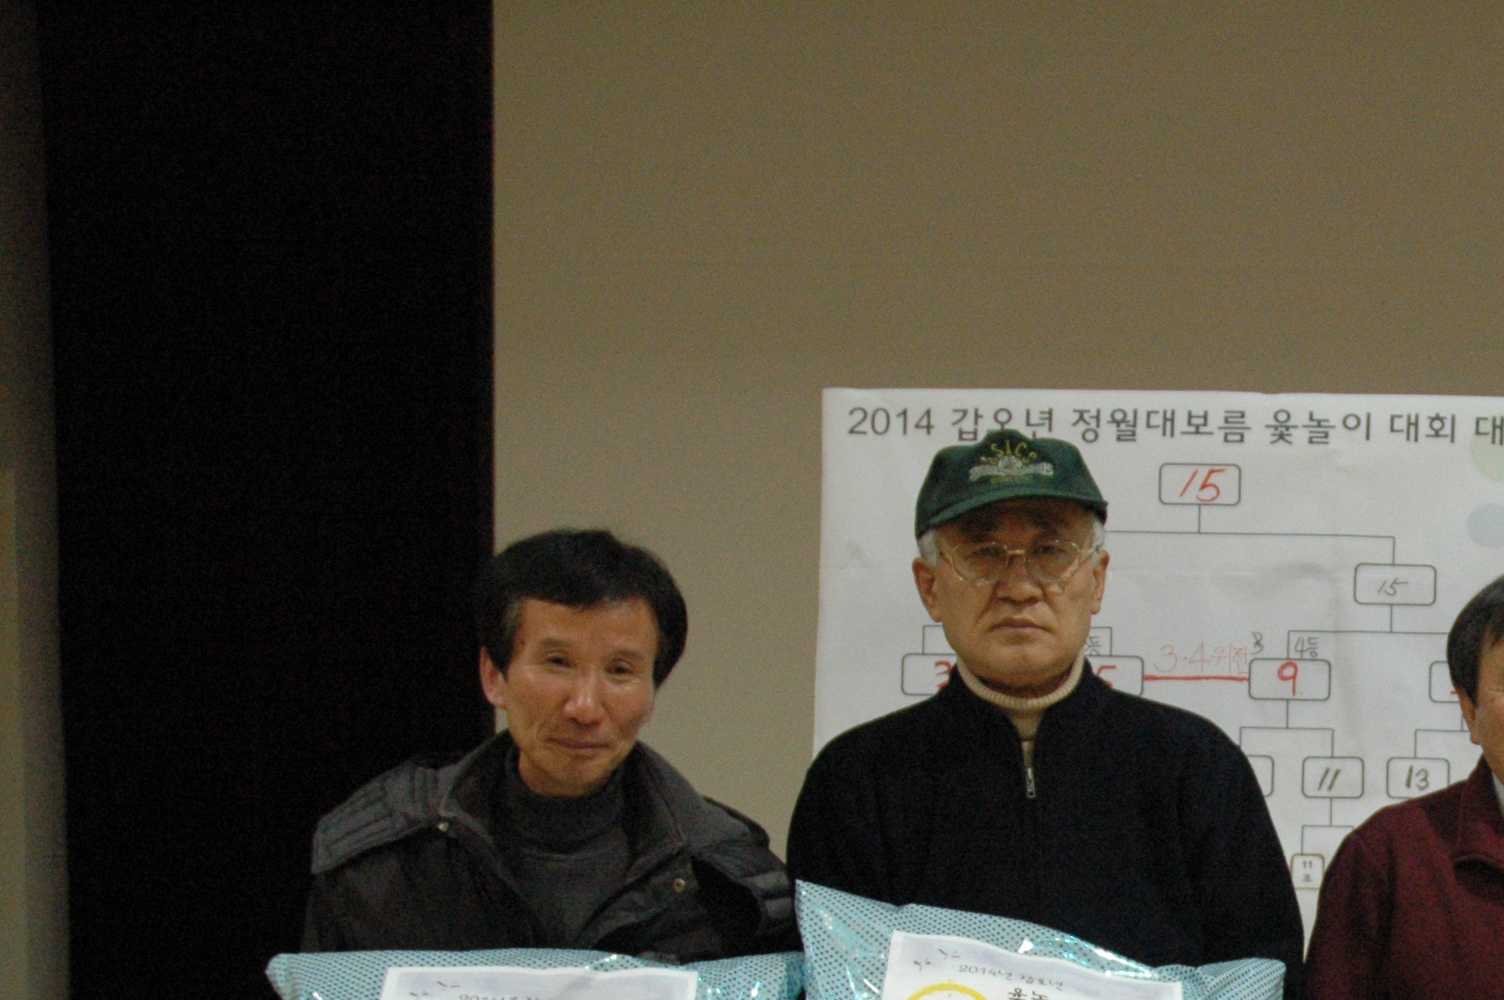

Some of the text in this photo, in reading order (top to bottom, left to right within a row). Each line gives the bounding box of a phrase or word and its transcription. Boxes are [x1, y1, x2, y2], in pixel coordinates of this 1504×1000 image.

[848, 406, 935, 436] 2014
[1071, 406, 1252, 444] 정월대보름
[1264, 408, 1372, 445] 윷놀이
[1389, 412, 1457, 444] 대회
[1179, 467, 1228, 503] 15
[1377, 577, 1409, 597] 15
[1277, 660, 1299, 696] 9
[1316, 766, 1342, 792] 11
[1404, 764, 1430, 791] 13
[959, 964, 1013, 981] 2014년
